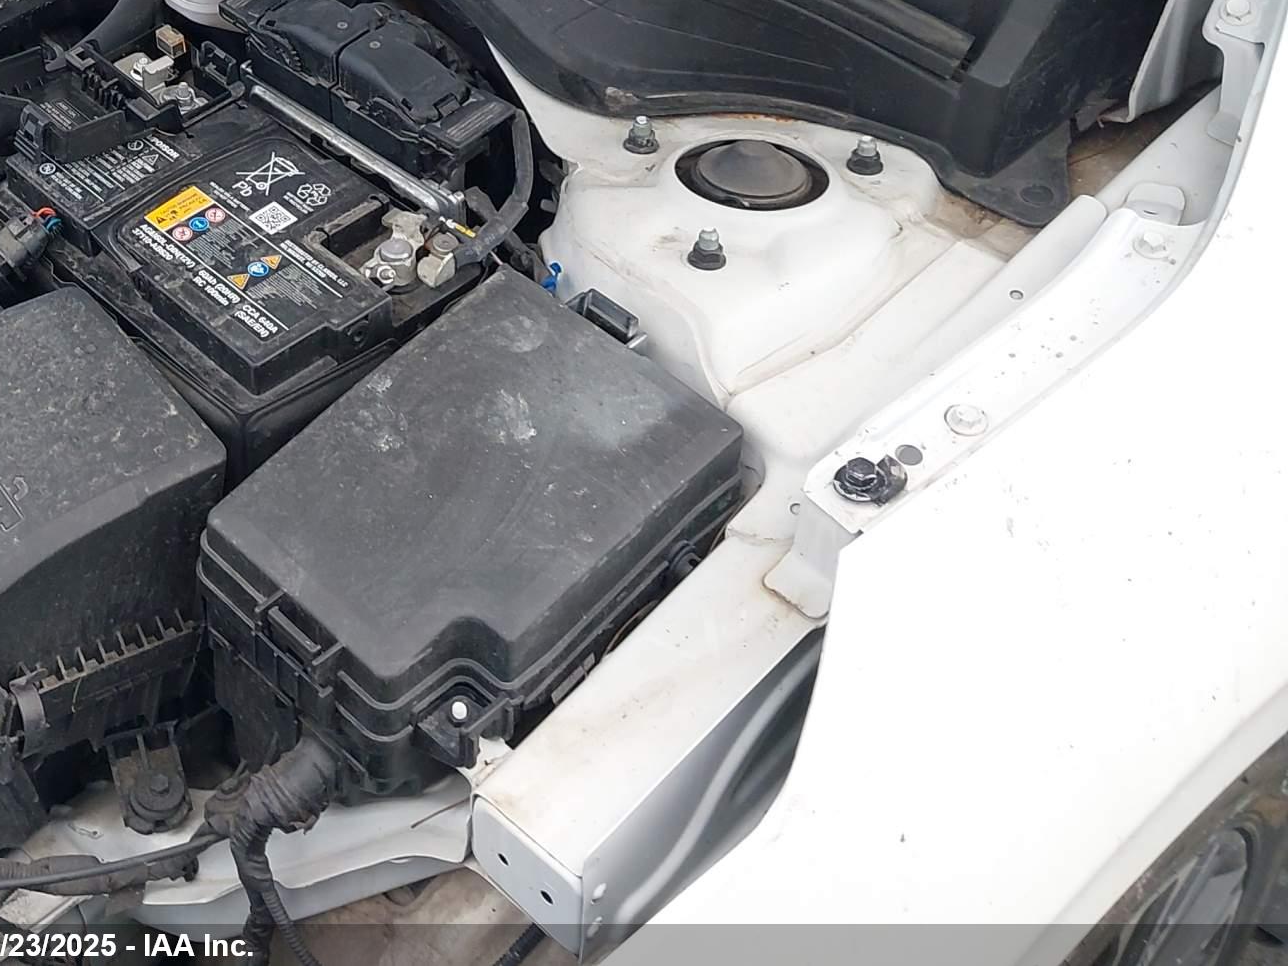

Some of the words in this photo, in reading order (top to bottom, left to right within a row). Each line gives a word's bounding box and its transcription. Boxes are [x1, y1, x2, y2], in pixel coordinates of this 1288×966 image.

[232, 181, 253, 197] Pb
[192, 276, 206, 287] RC
[204, 285, 230, 306] 100min
[234, 310, 270, 338] (SAE/EN)
[242, 304, 260, 319] CCA
